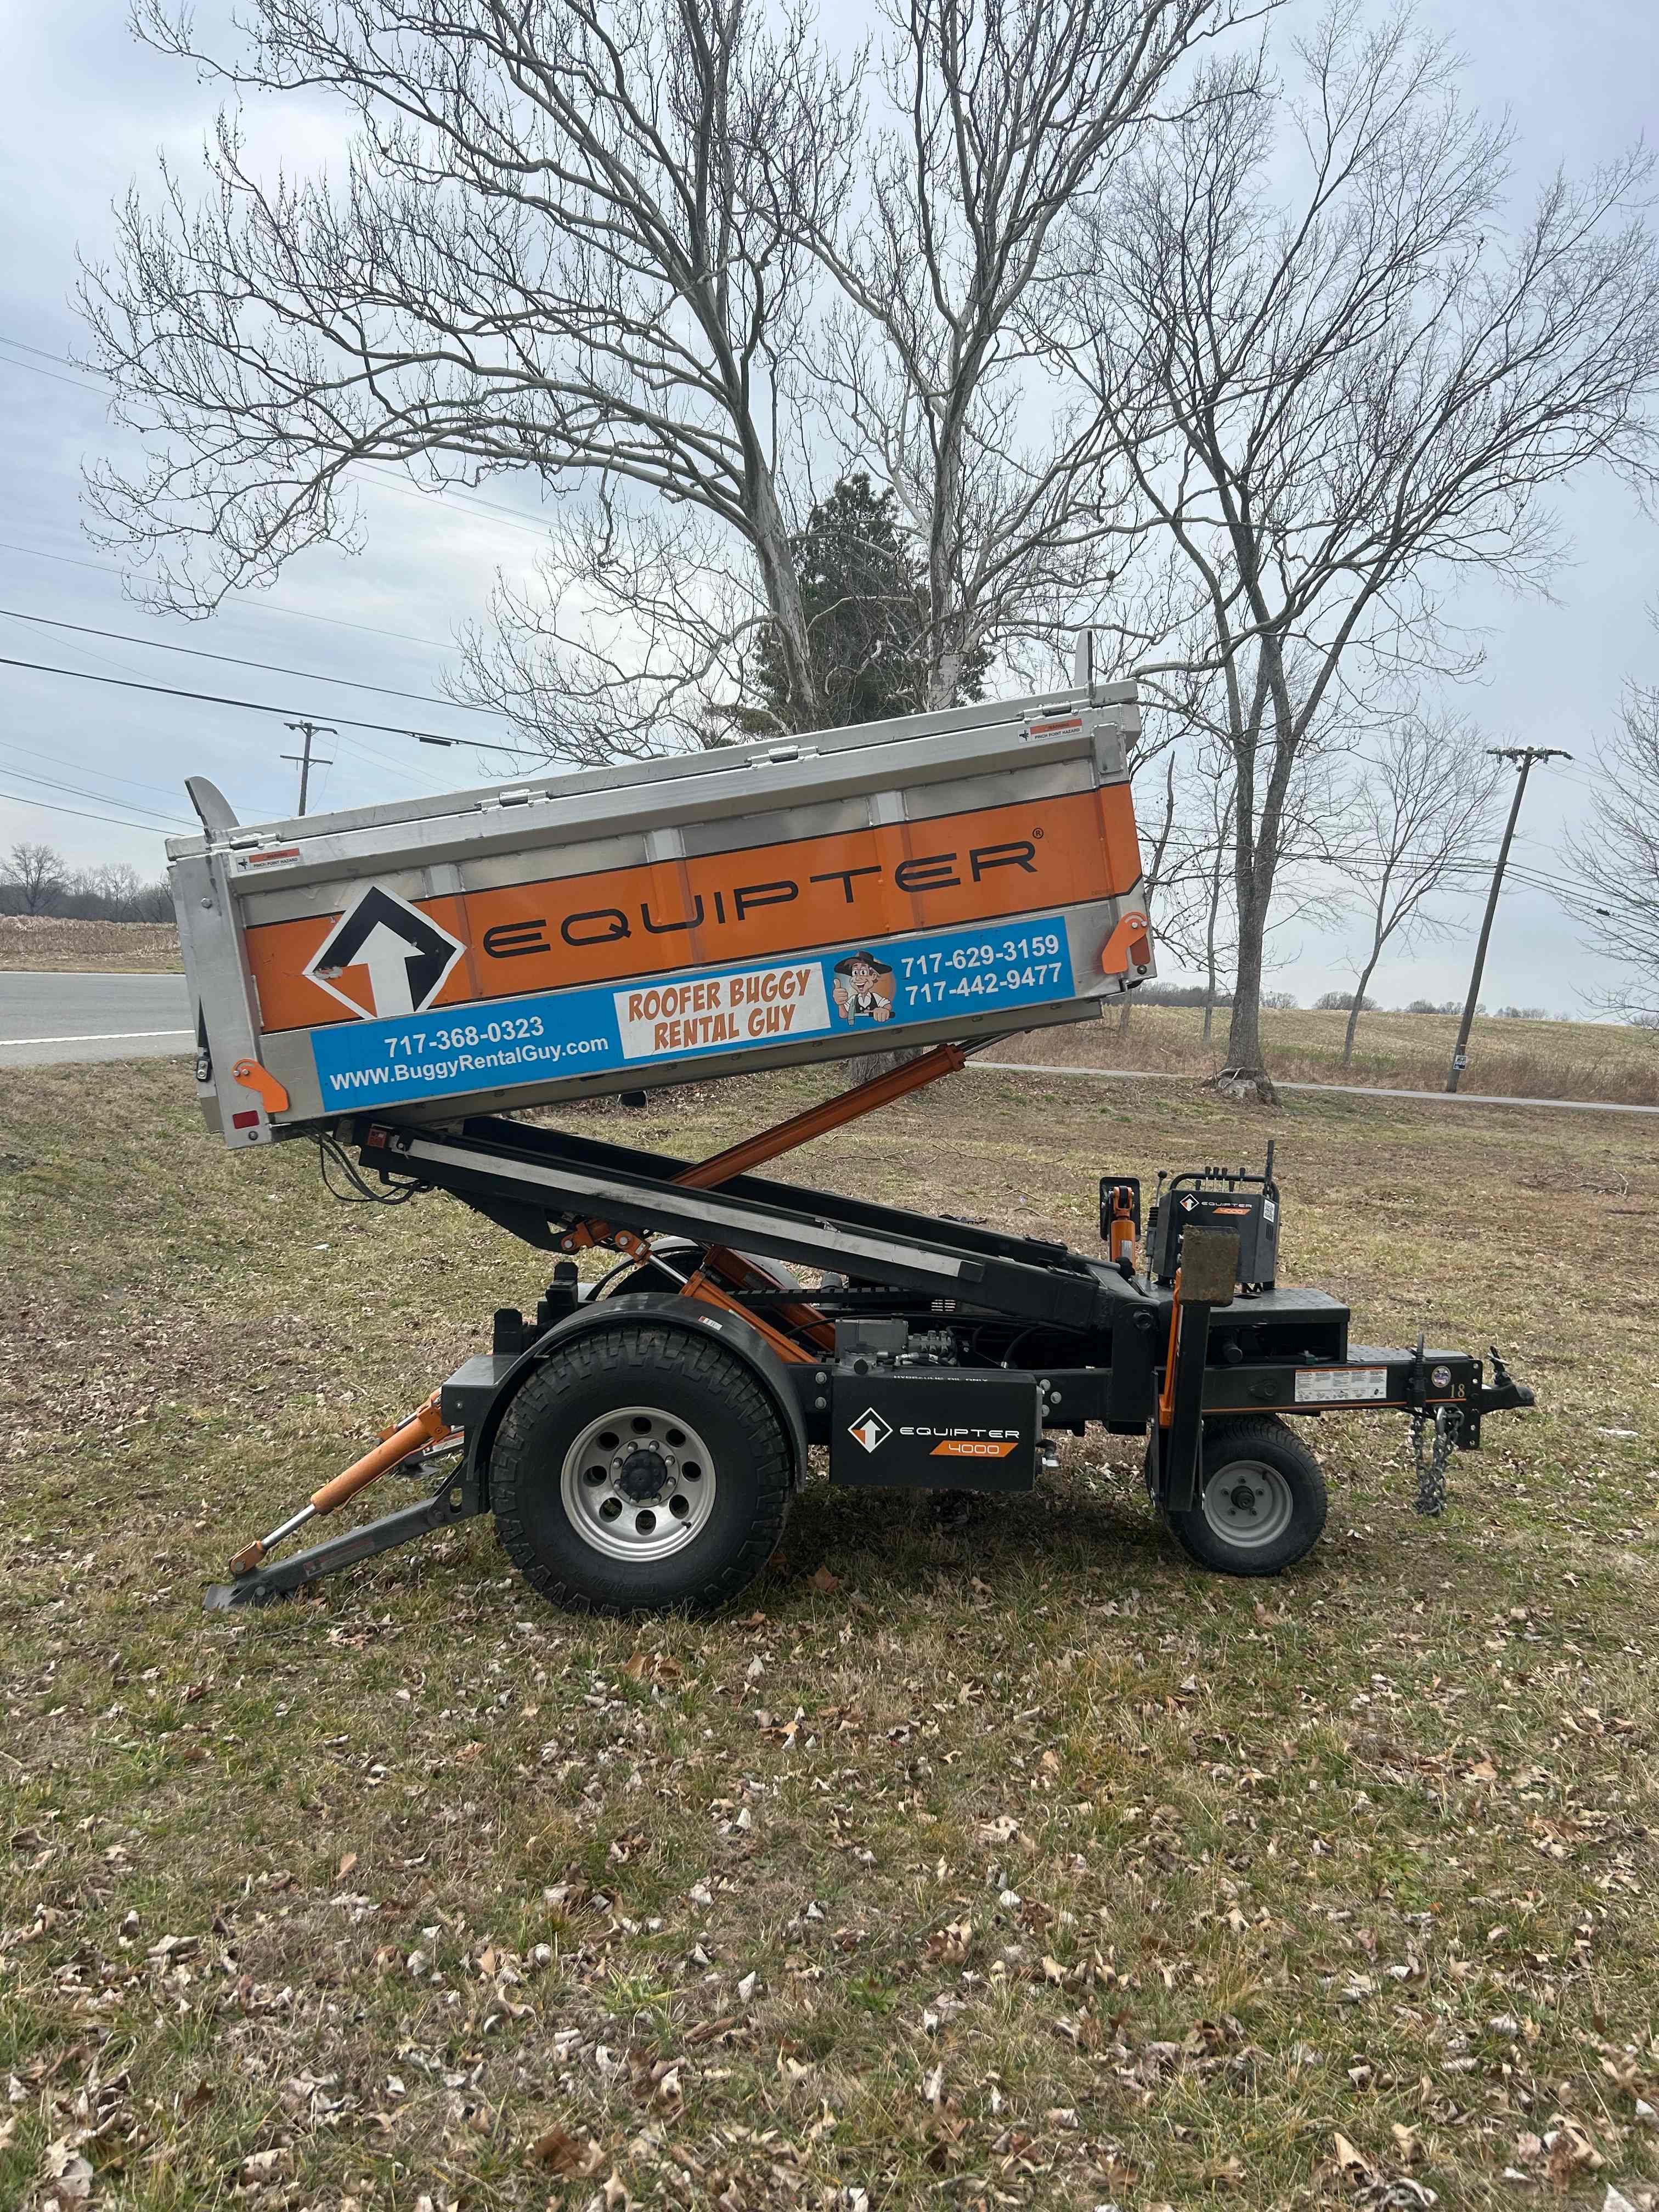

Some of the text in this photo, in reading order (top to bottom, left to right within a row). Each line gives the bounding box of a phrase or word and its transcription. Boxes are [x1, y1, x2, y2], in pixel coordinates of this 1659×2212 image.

[901, 934, 1059, 978] 717-629-3159
[629, 968, 811, 1023] ROOFER BUGGY
[905, 962, 1062, 1006] 717-442-9477
[385, 1016, 545, 1058] 717-368-0323
[654, 1003, 796, 1051] RENTAL GUY
[1450, 1383, 1465, 1398] 18
[899, 1426, 1020, 1438] EQUIPTER
[949, 1443, 1000, 1454] 4000
